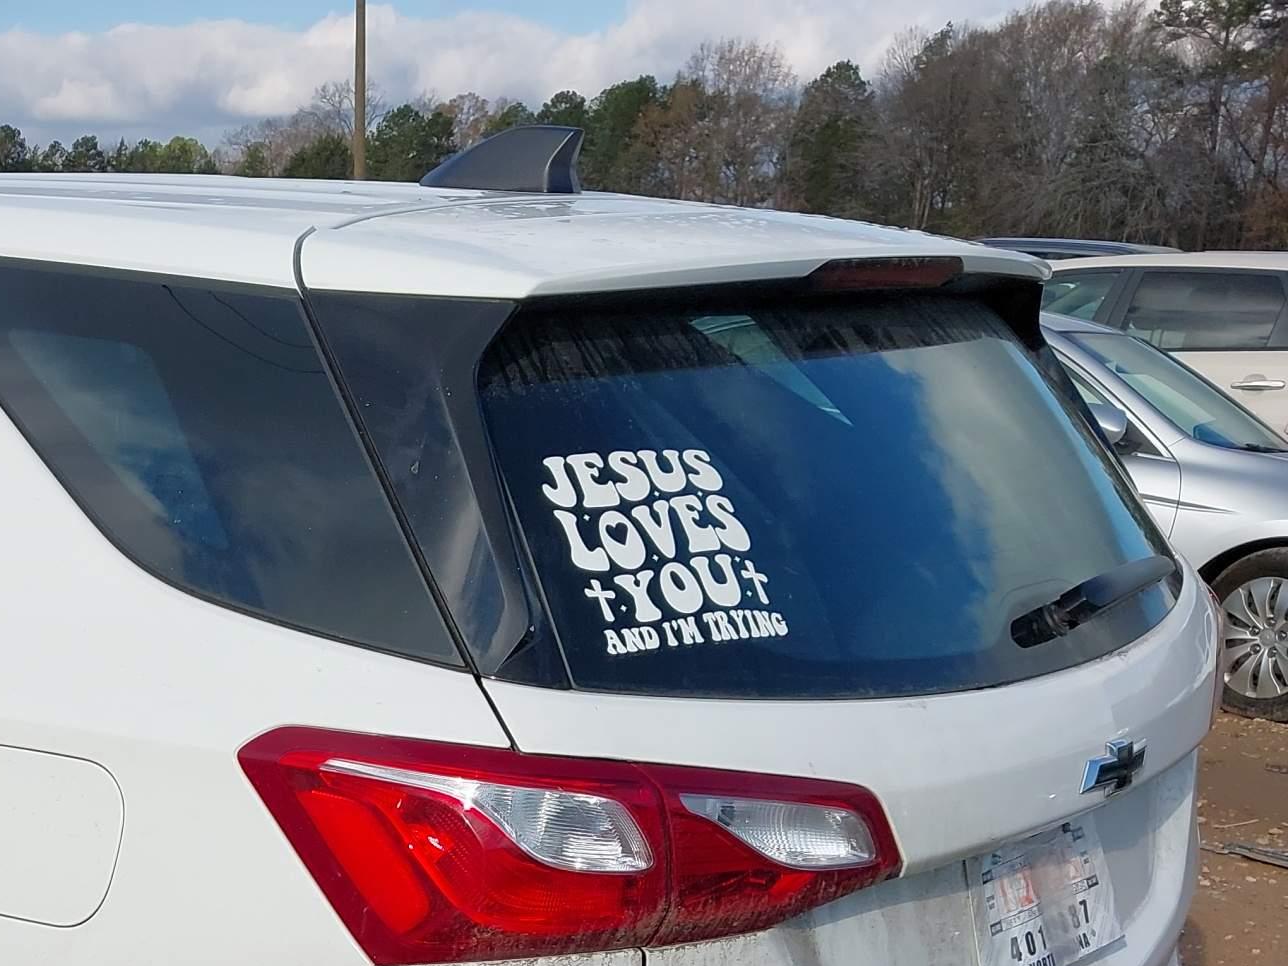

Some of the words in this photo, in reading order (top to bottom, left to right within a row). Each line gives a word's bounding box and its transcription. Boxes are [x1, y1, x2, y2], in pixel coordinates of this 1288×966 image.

[542, 449, 723, 508] JESUS
[553, 495, 751, 572] LOVES
[614, 554, 741, 623] YOU
[603, 626, 661, 655] AND
[662, 617, 705, 646] I'M
[703, 609, 789, 642] TRYING
